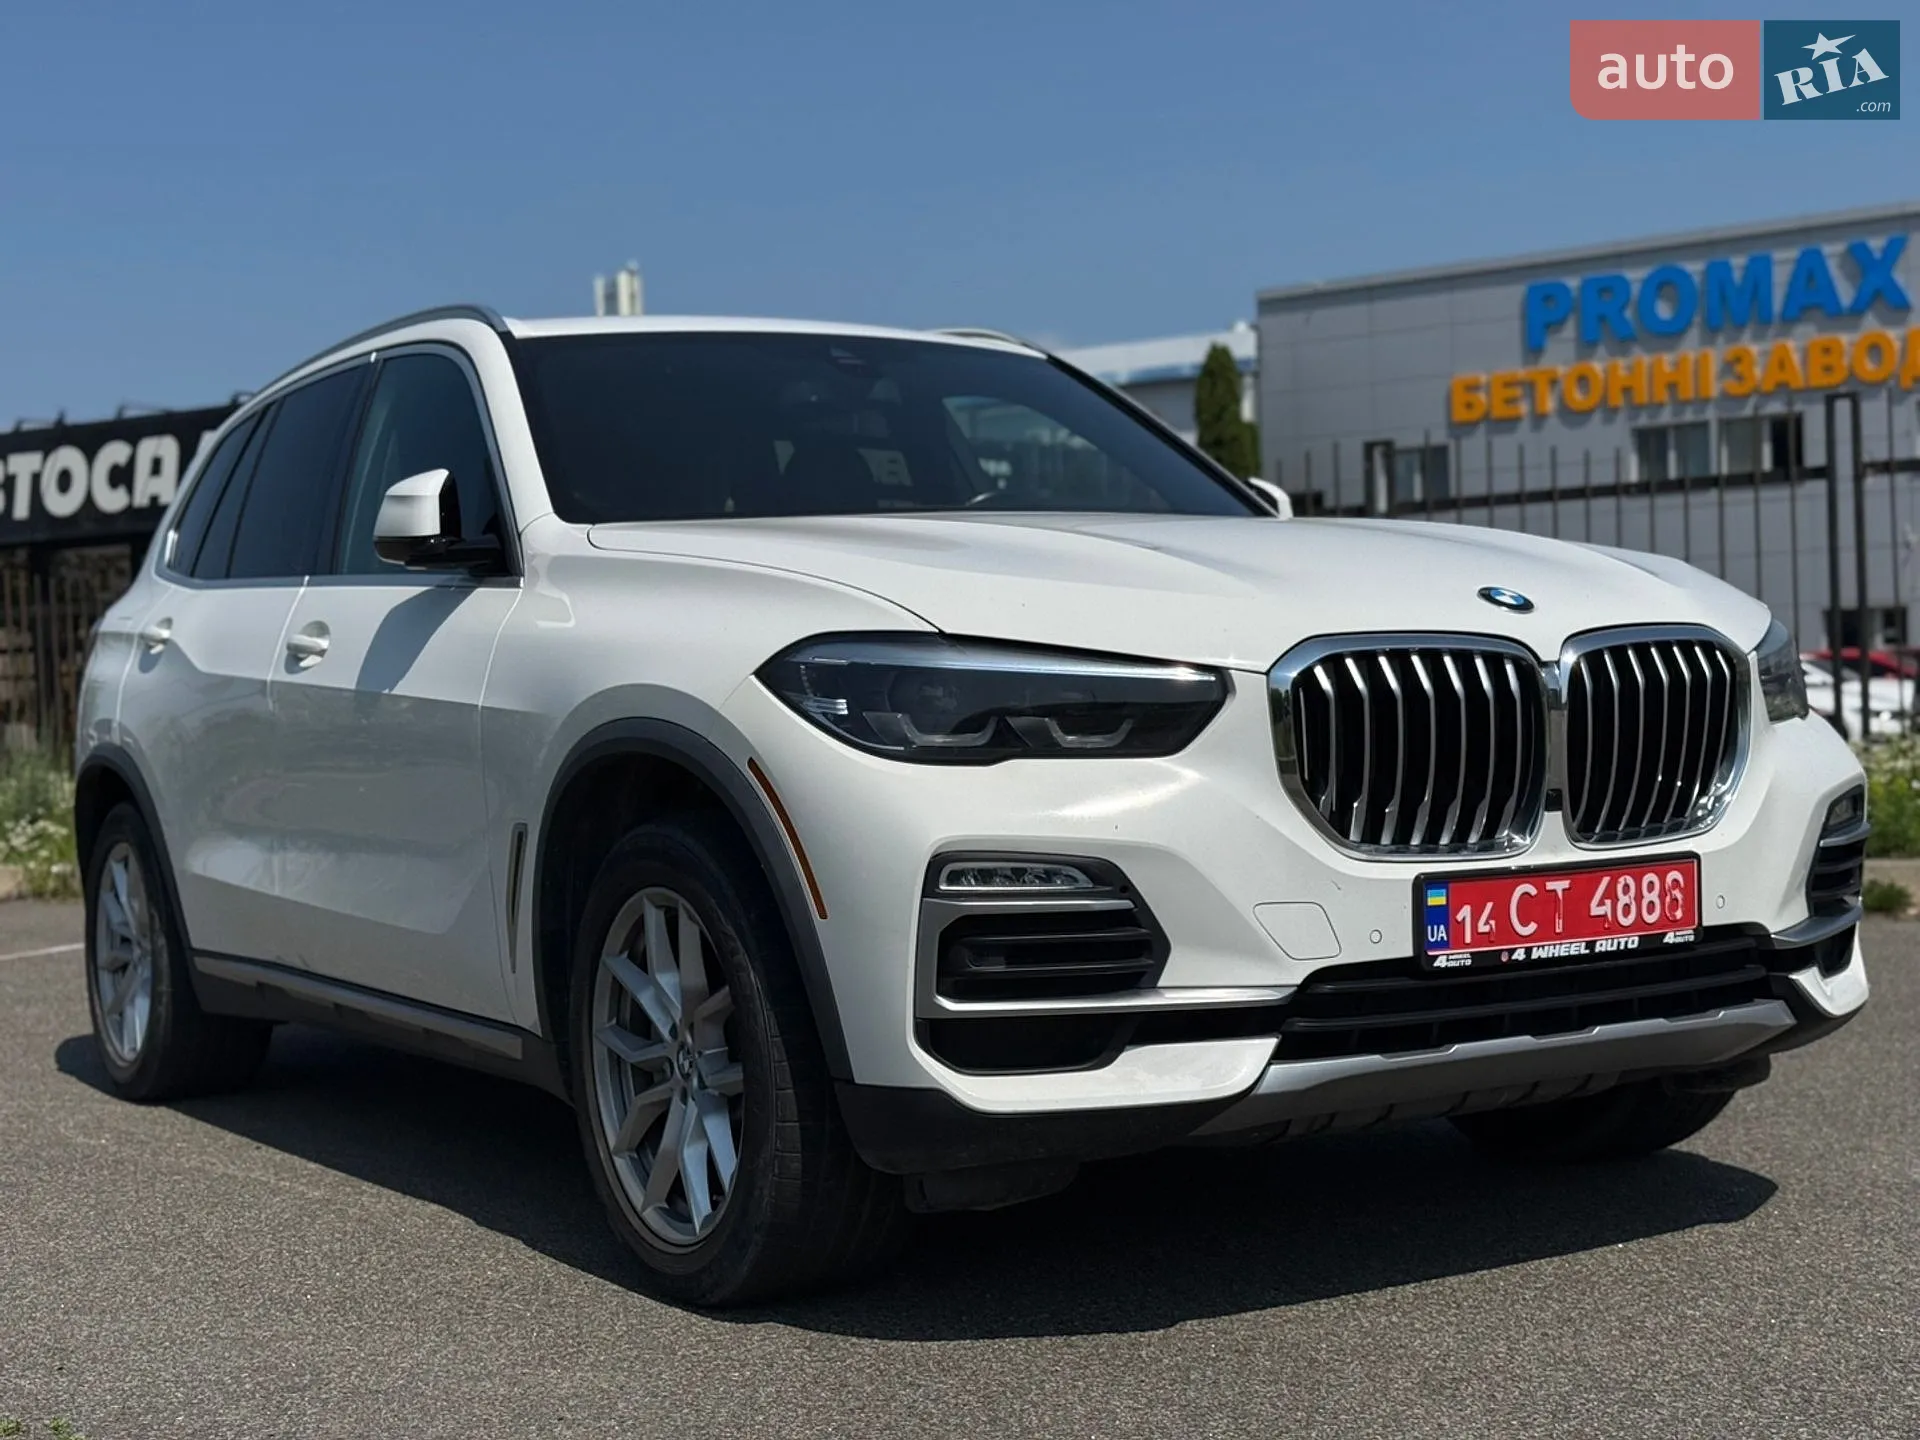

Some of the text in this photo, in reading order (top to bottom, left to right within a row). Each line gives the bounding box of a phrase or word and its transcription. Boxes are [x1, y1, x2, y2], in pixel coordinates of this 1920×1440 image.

[1525, 234, 1911, 351] PROMAX
[0, 430, 217, 521] ТОСА
[1427, 924, 1448, 943] UA
[1456, 902, 1496, 944] 14
[1509, 880, 1571, 936] CT
[1511, 936, 1639, 960] 4 WHEEL AUTO
